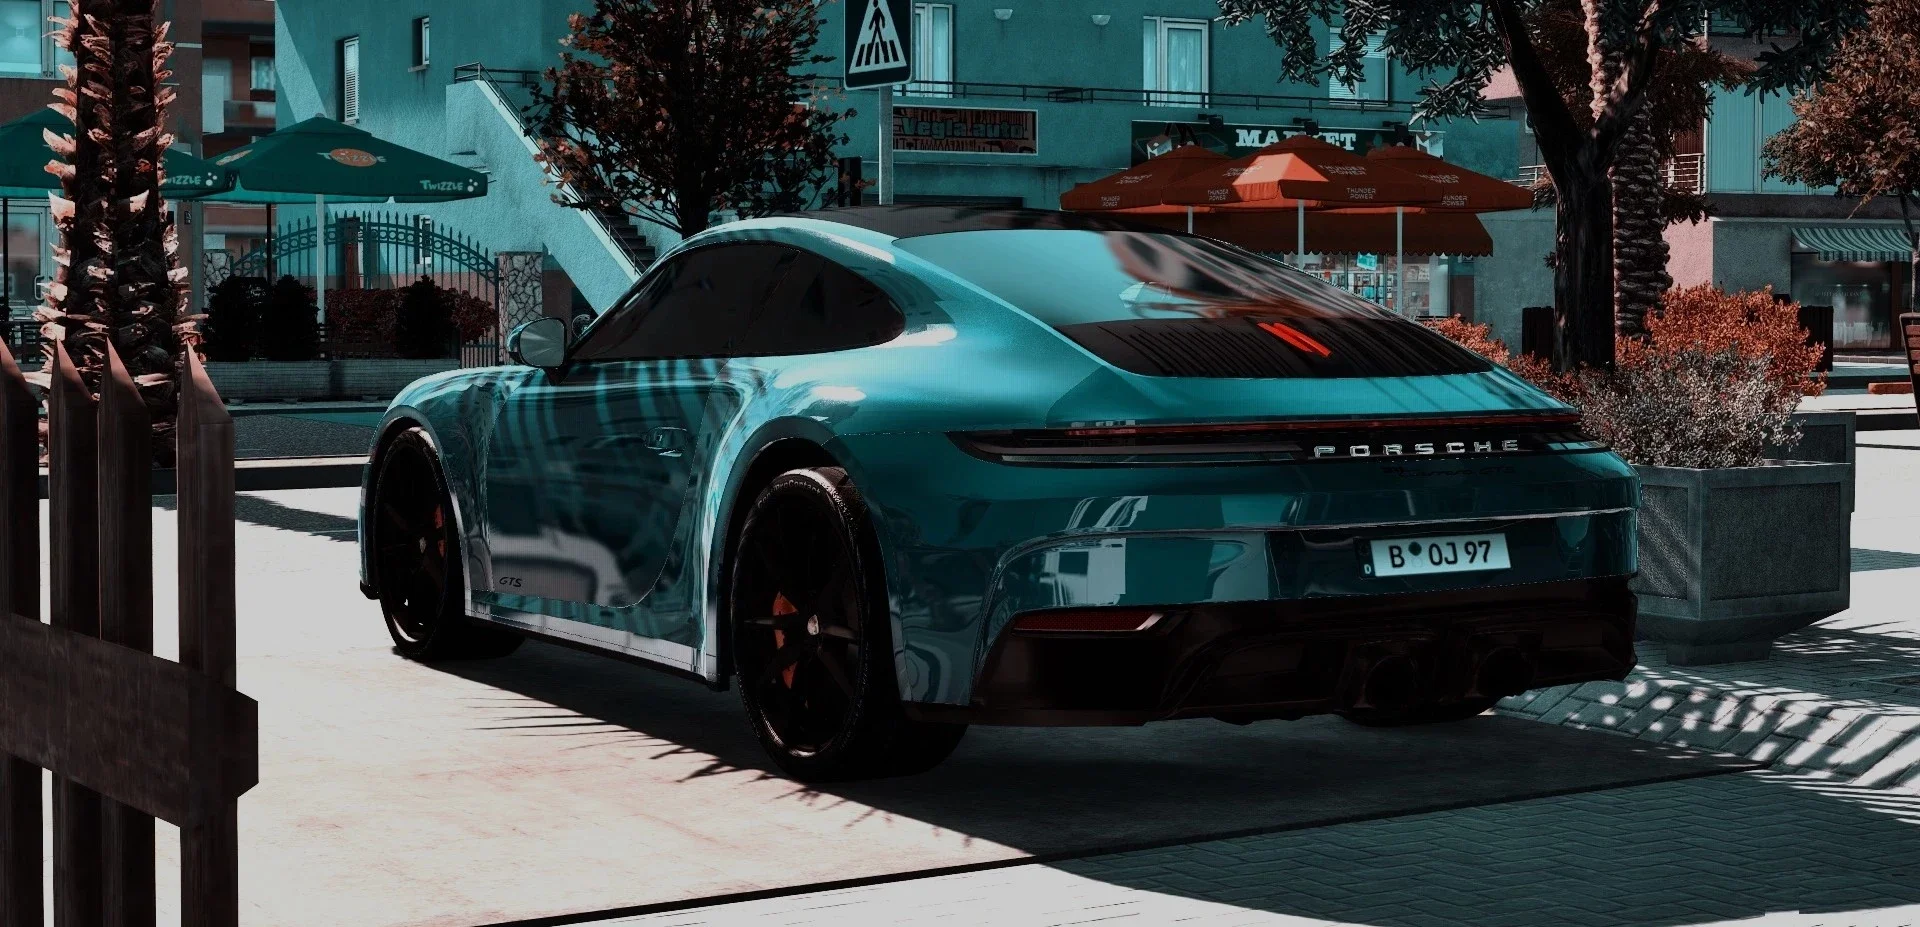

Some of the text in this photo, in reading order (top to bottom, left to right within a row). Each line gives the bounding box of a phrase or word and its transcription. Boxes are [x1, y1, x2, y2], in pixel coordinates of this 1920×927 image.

[901, 116, 1024, 140] Vegla auto
[1235, 128, 1357, 151] MAET
[1347, 187, 1377, 195] THUNDER
[1313, 439, 1520, 459] PORSCHE
[1389, 541, 1490, 568] B OJ 97
[499, 576, 522, 588] GTS
